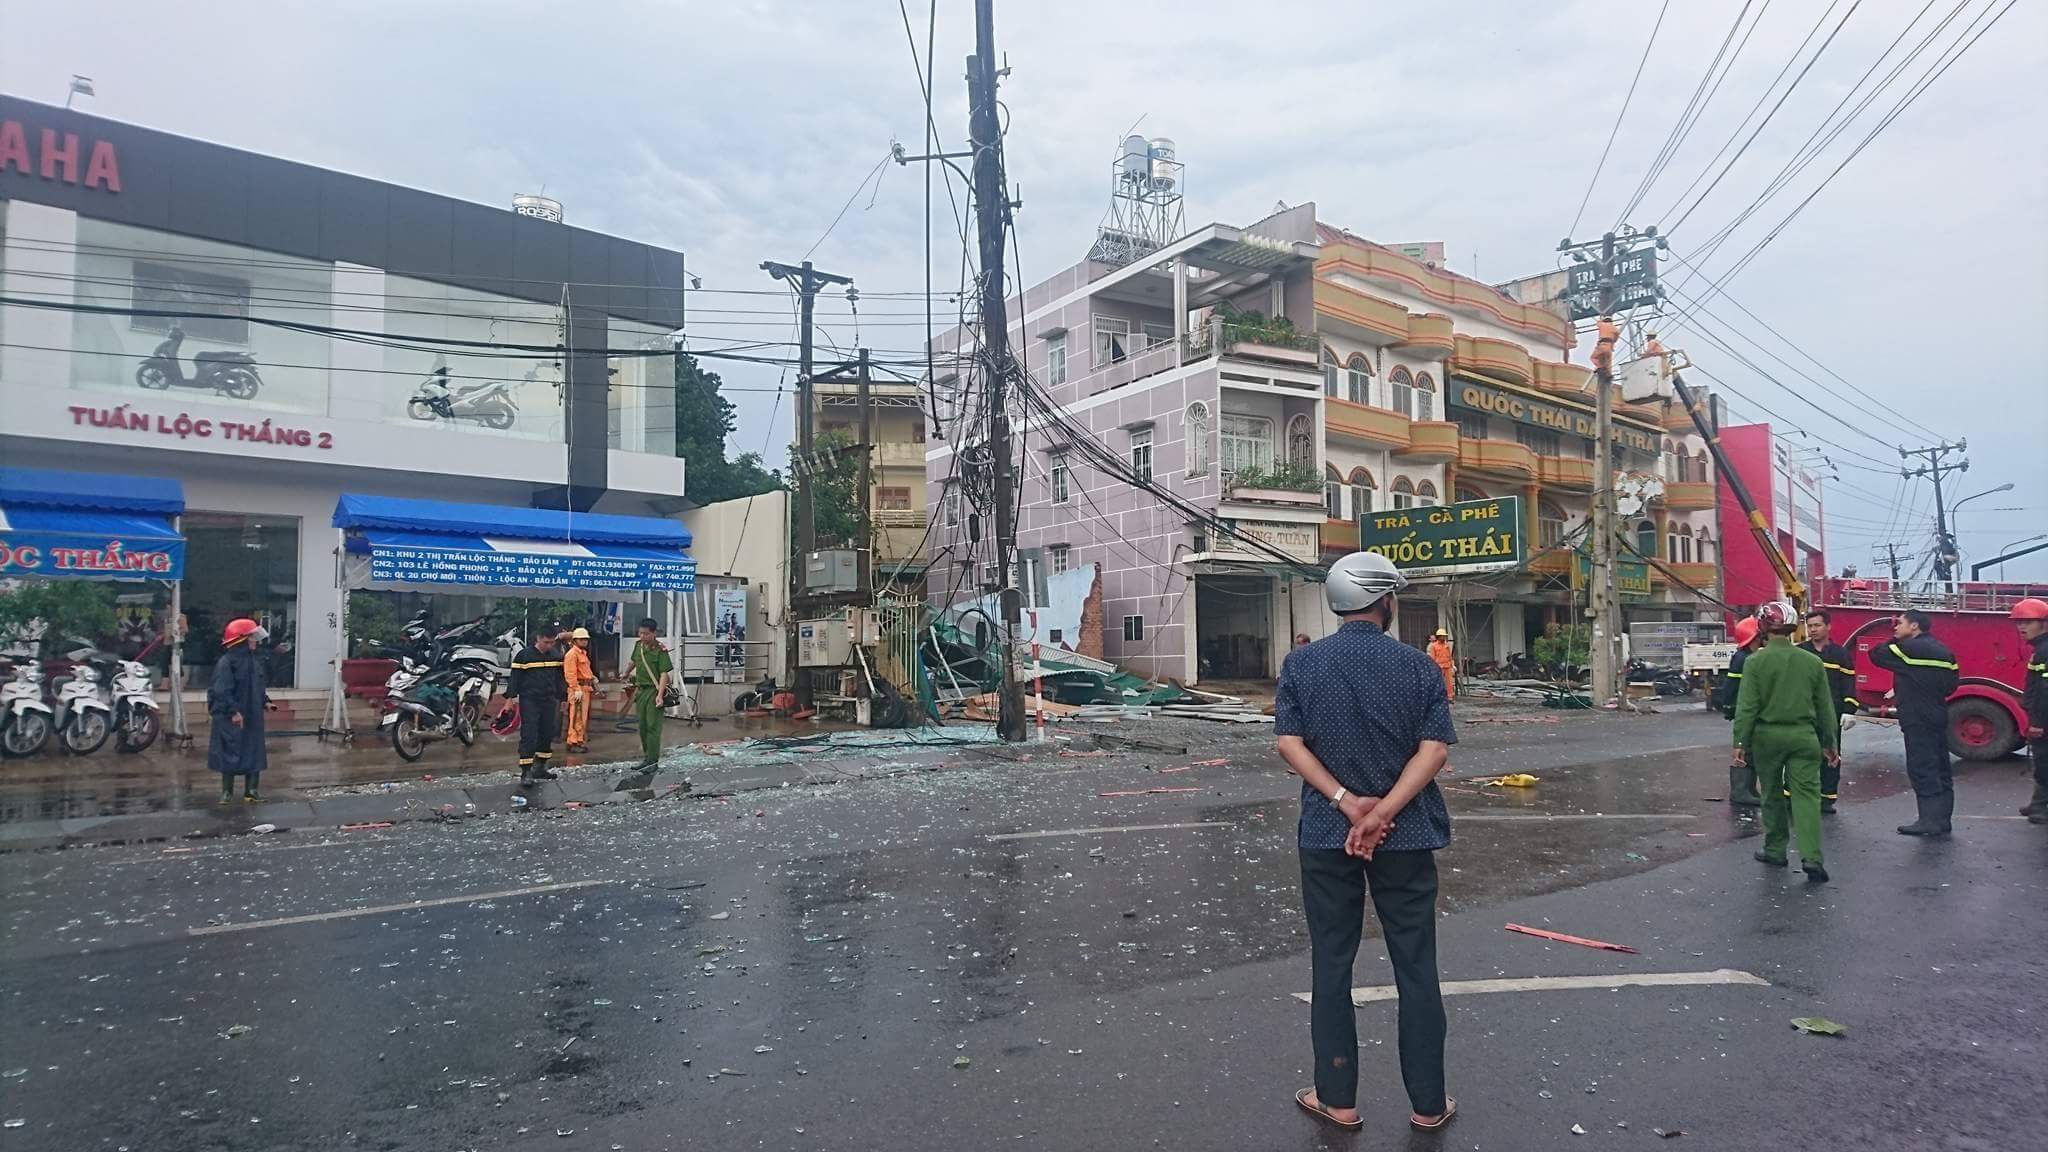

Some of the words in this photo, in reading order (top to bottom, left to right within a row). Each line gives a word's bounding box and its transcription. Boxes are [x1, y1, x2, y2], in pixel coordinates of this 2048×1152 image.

[69, 404, 149, 431] TUẤN
[158, 413, 211, 439] LỘC
[220, 418, 311, 447] THẮNG
[318, 432, 332, 449] 2
[1462, 388, 1523, 418] QUỐC
[1529, 406, 1571, 431] THÁI
[1576, 418, 1620, 443] DAH
[1628, 432, 1655, 453] TRÀ
[1374, 514, 1410, 529] TRÀ
[1429, 508, 1454, 524] CÀ
[1461, 503, 1500, 521] PHÊ
[52, 540, 171, 572] THẮNG
[1440, 527, 1511, 559] THÁI
[459, 564, 489, 572] PHONG
